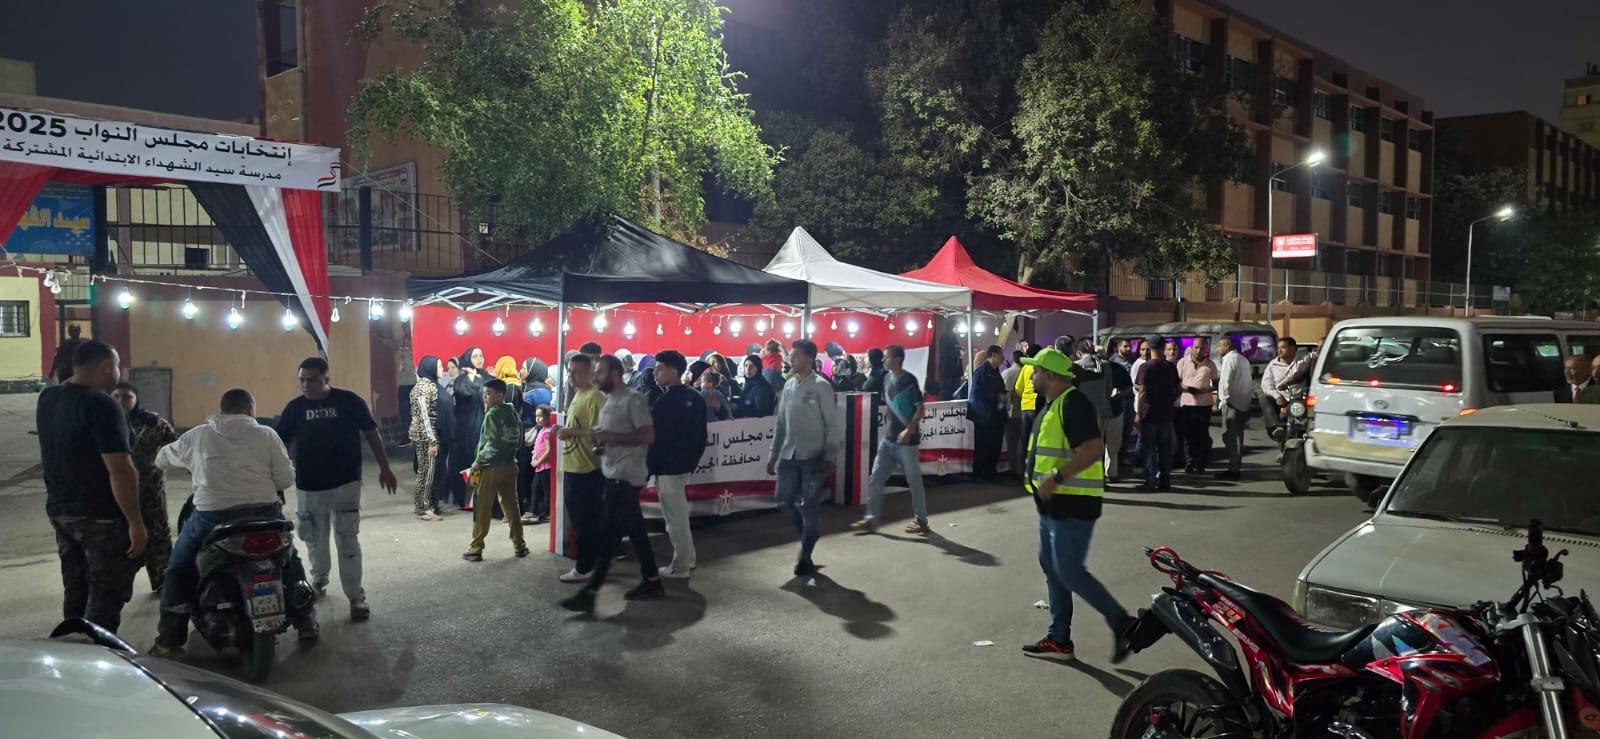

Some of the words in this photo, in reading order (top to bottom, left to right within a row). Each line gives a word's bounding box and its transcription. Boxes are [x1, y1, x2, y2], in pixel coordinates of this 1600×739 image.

[75, 123, 137, 143] النواب
[3, 138, 72, 157] المشتركة
[145, 133, 209, 153] مجلس
[77, 147, 140, 167] الابتدائية
[214, 140, 292, 166] إنتخابات
[145, 157, 201, 172] الشهداء
[206, 166, 235, 177] سيد
[239, 165, 282, 181] مدرسة
[940, 406, 967, 421] مجلس
[723, 428, 763, 449] مجلس
[939, 425, 966, 436] محافظة
[721, 451, 761, 467] محافظة
